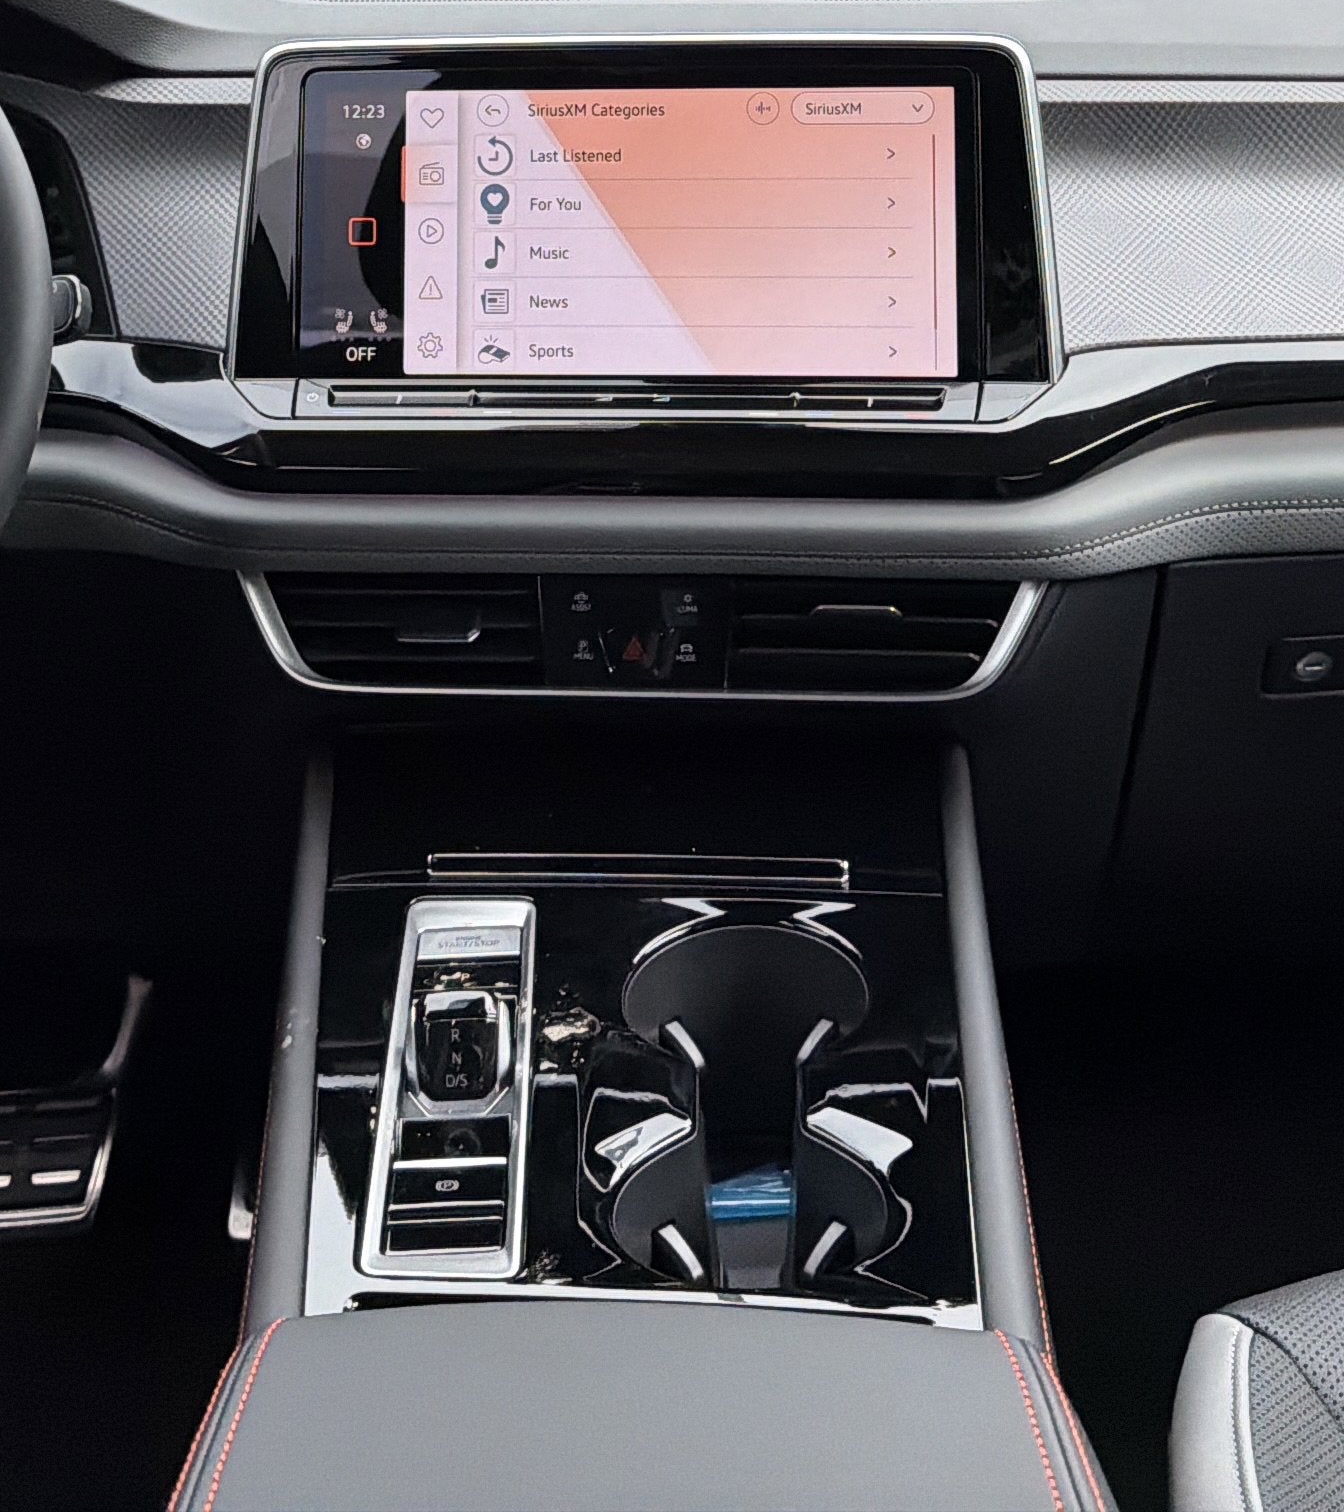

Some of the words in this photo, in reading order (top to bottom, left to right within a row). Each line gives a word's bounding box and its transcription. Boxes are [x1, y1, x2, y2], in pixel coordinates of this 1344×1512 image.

[342, 104, 386, 119] 12:23
[527, 103, 587, 118] SiriusXM
[591, 103, 666, 120] Categories
[805, 102, 862, 116] SiriusXM
[530, 149, 559, 163] Last
[563, 148, 622, 163] Listened
[530, 198, 552, 211] For
[556, 198, 582, 211] You
[529, 246, 570, 260] Music
[529, 294, 569, 309] News
[345, 346, 377, 362] OFF
[528, 343, 574, 361] Sports
[450, 1029, 461, 1042] R
[451, 1053, 462, 1065] N
[445, 1073, 469, 1088] D/S
